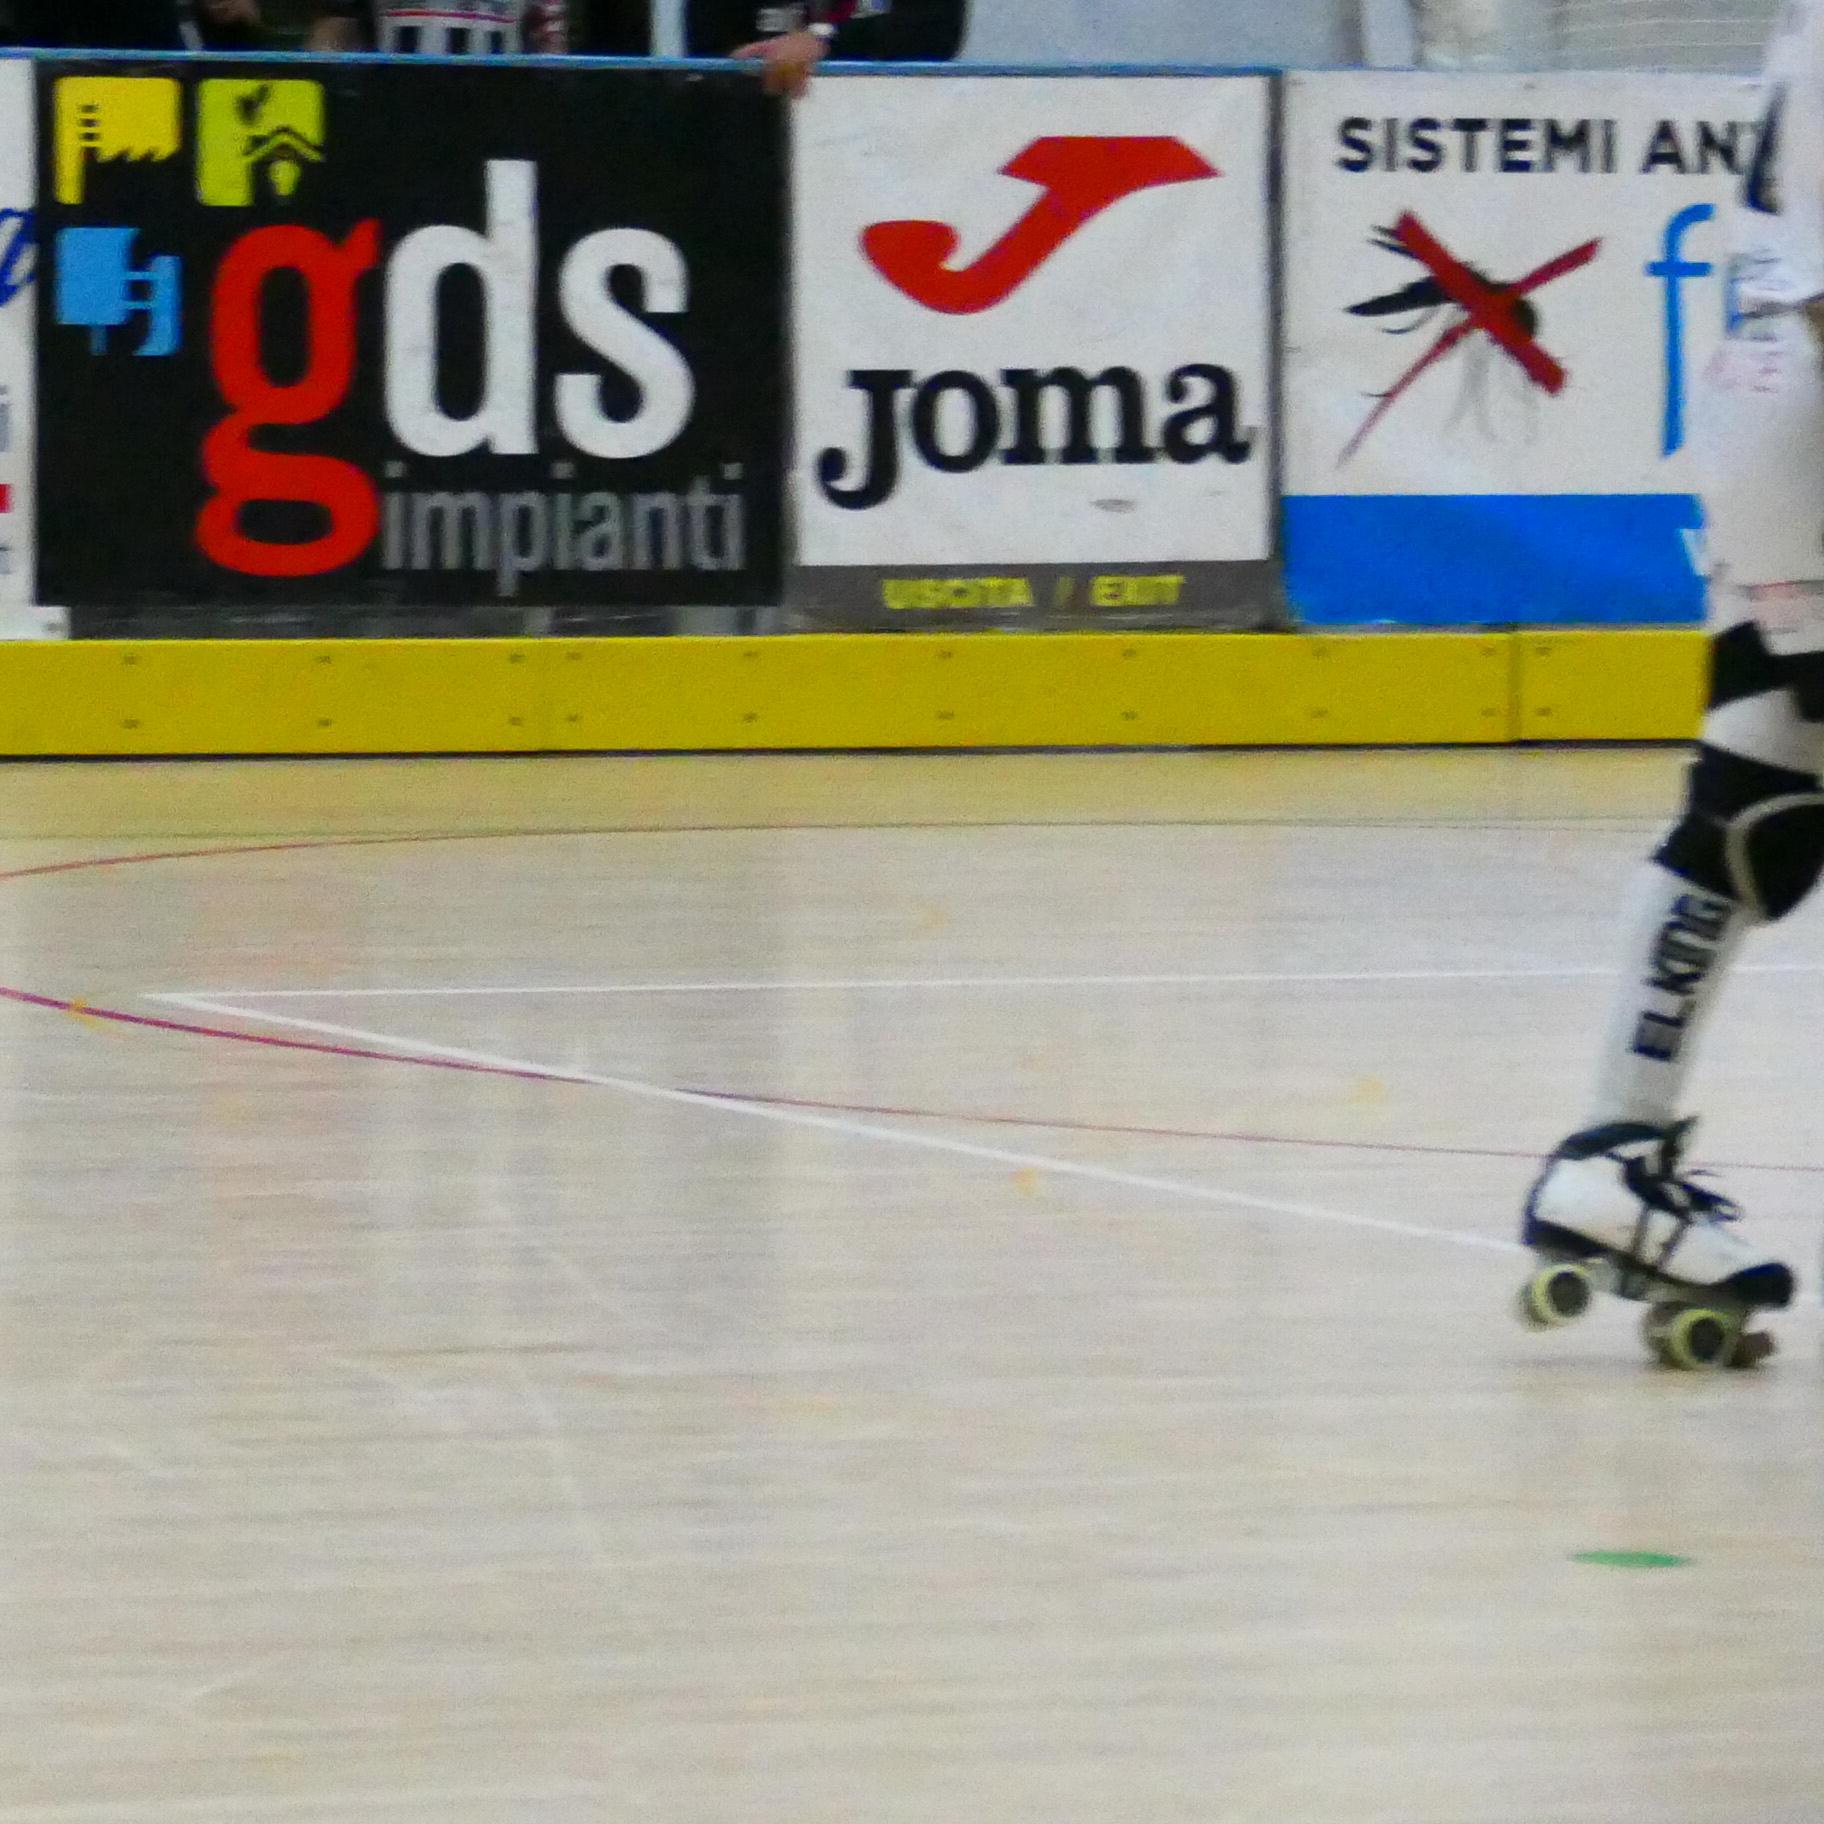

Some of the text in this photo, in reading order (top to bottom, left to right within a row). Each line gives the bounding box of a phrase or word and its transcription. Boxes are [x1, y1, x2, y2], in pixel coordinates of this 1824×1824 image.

[1335, 116, 1618, 176] SISTEMI
[193, 158, 697, 577] gds
[379, 460, 745, 598] impianti
